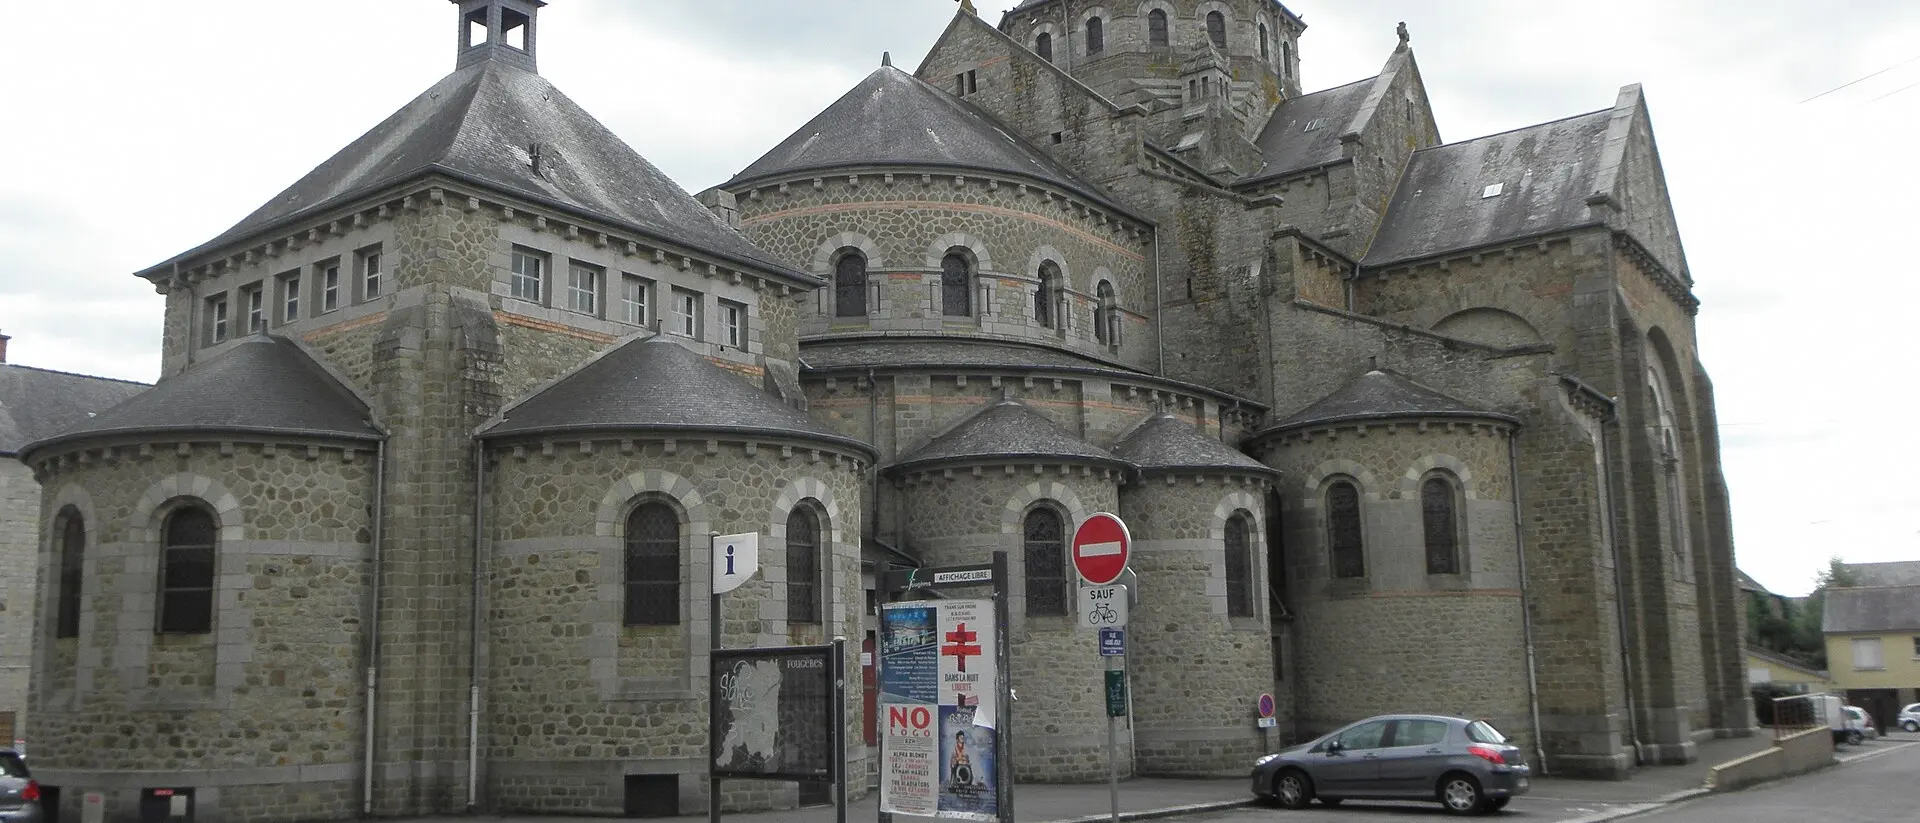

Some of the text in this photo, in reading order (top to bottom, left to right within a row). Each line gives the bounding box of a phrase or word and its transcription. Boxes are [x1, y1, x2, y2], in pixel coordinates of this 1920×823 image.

[938, 570, 988, 582] AFFICHAGE LIBRE
[1090, 588, 1114, 600] SAUF
[944, 673, 979, 682] DANS LA NUIT
[890, 706, 931, 730] NO
[890, 729, 931, 737] LOGO
